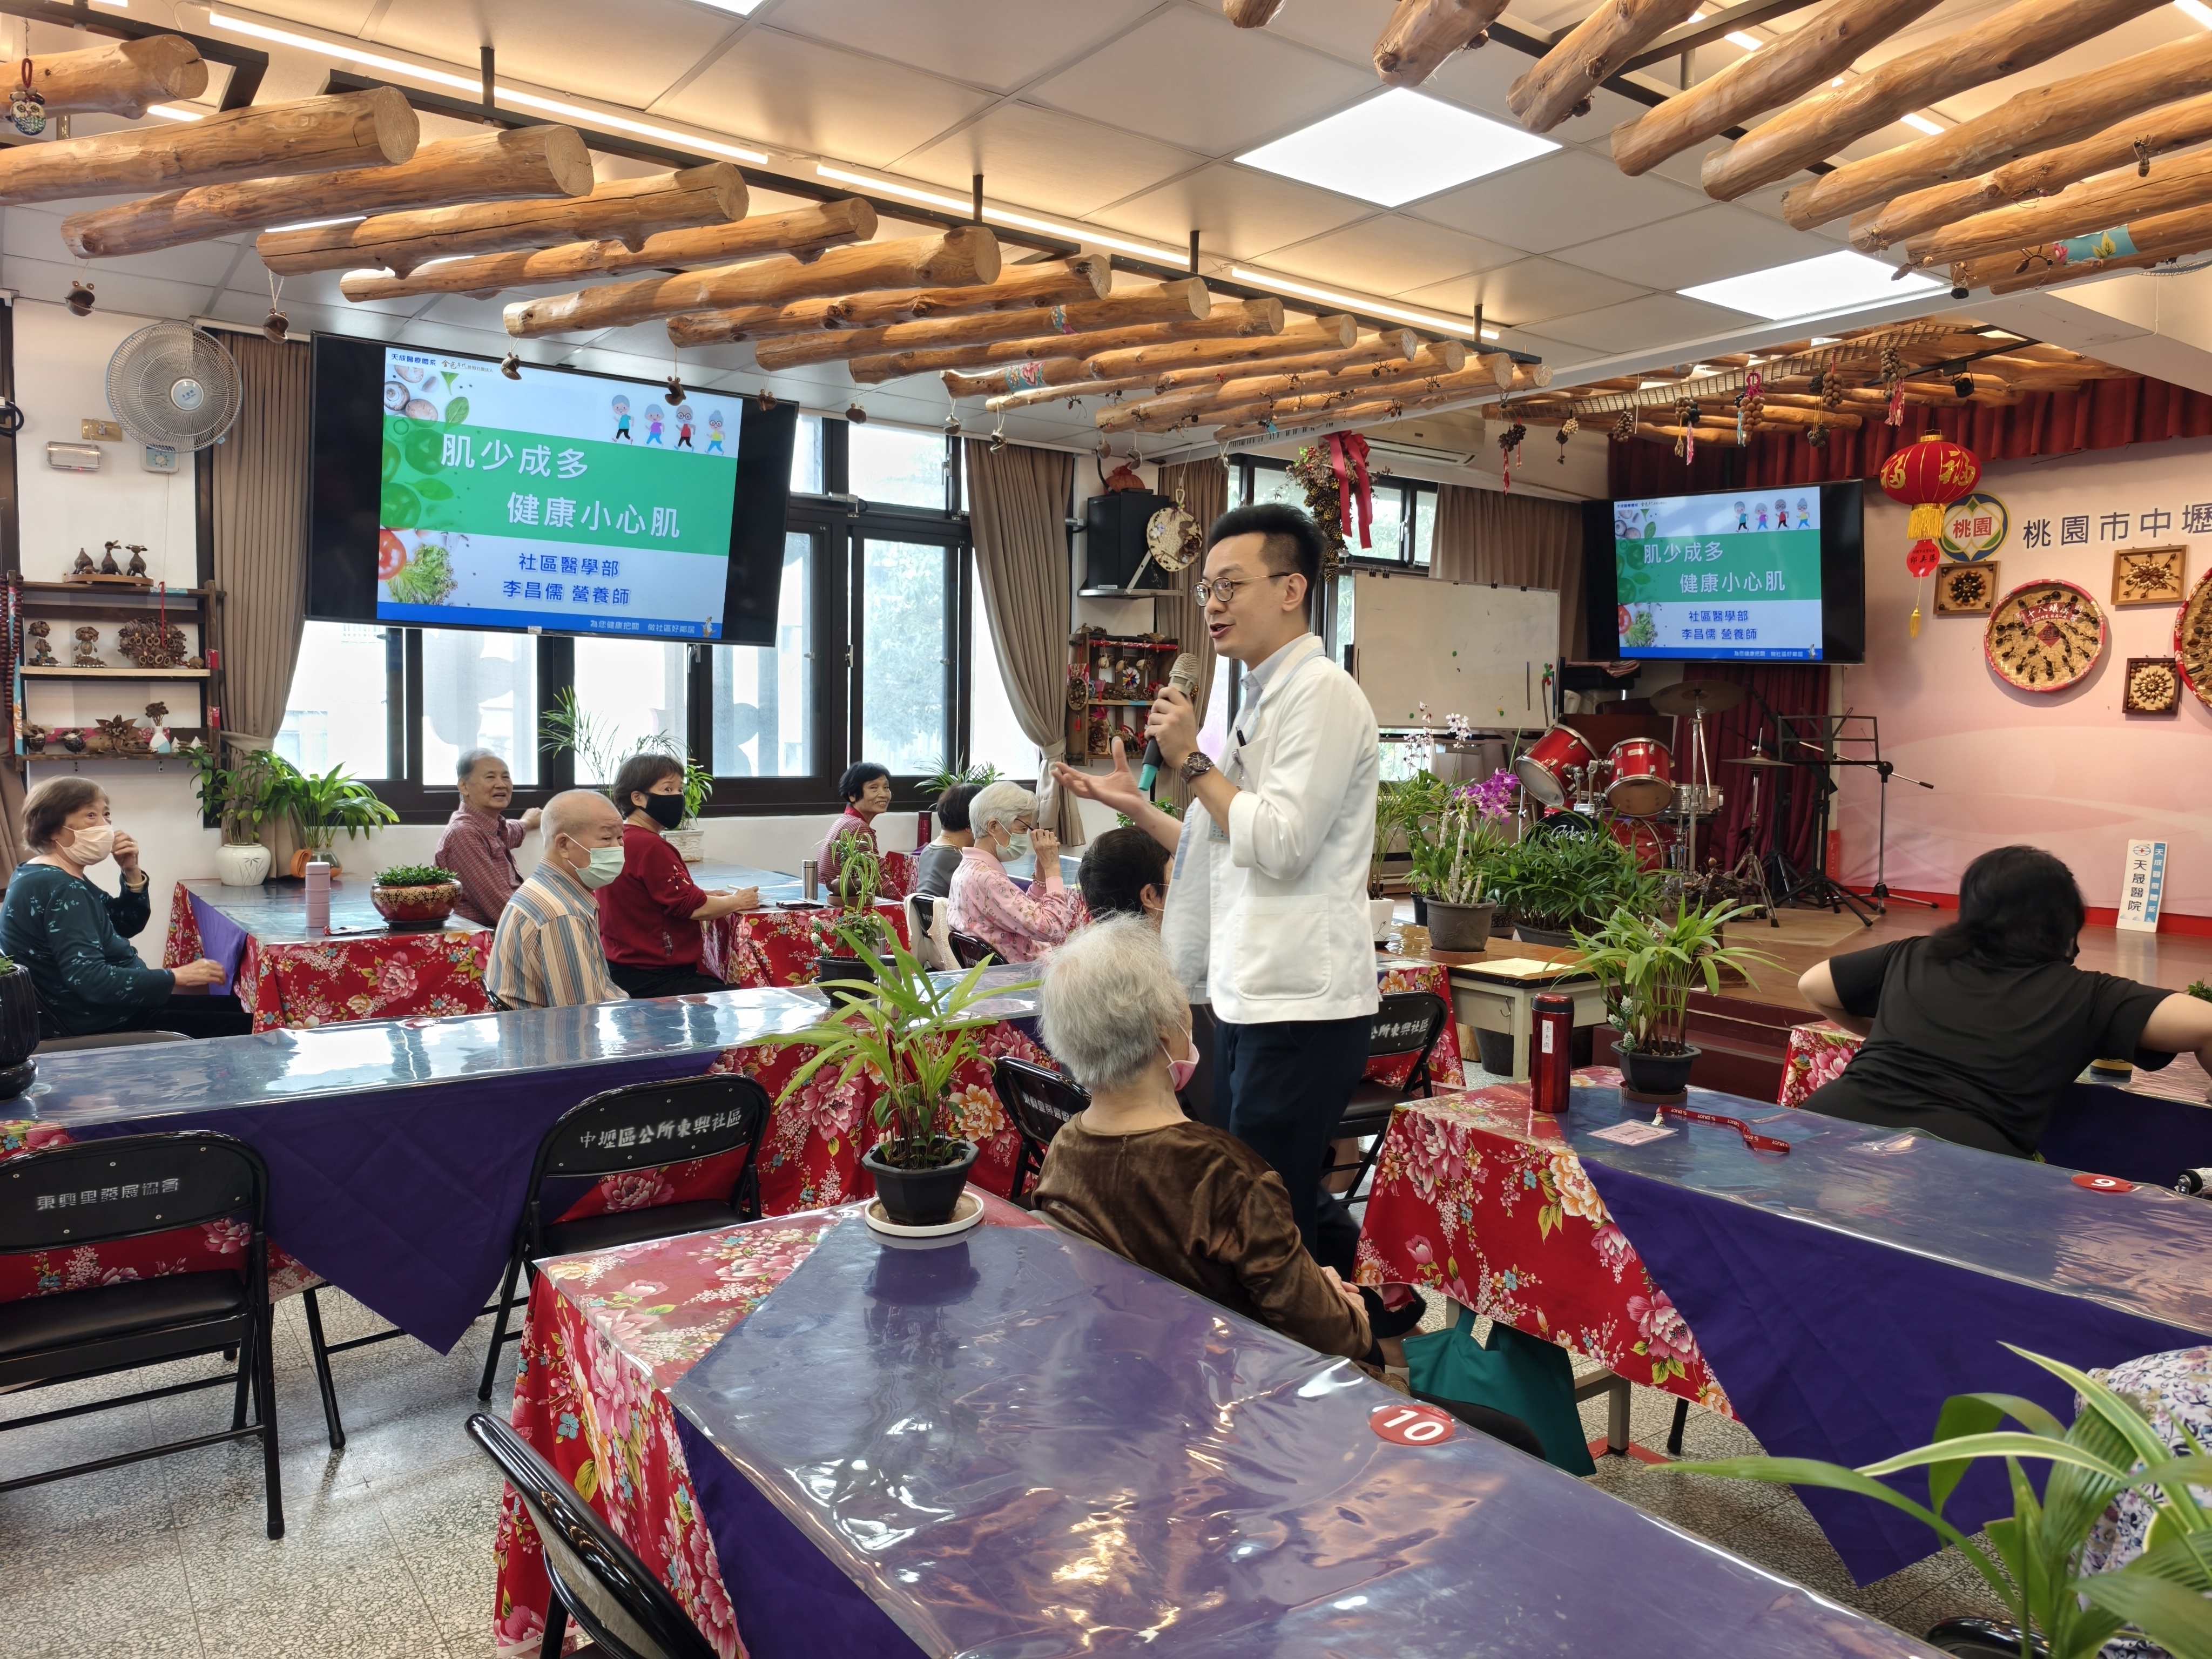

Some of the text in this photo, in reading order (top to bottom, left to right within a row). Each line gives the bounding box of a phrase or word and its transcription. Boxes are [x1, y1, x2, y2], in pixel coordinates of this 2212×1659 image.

[391, 353, 436, 366] 天成醫療體系
[441, 434, 588, 479] 肌少成多
[507, 491, 680, 538] 健康小心肌
[1953, 517, 1992, 539] 桃園
[1644, 541, 1723, 564] 肌少成多
[519, 553, 619, 577] 社區醫學部
[503, 581, 630, 605] 李昌儒 營養師
[1680, 571, 1785, 594] 健康小心肌
[590, 620, 694, 633] 為您健康把關 做社區好鄰居
[1689, 610, 1748, 622] 社區醫學部
[1682, 629, 1757, 640] 李昌儒 營養師
[2128, 860, 2147, 912] 天晟醫院
[580, 1108, 741, 1148] 中壢區公所東興社區
[37, 1178, 179, 1210] 東興里發展協會
[1383, 1409, 1444, 1441] 10
